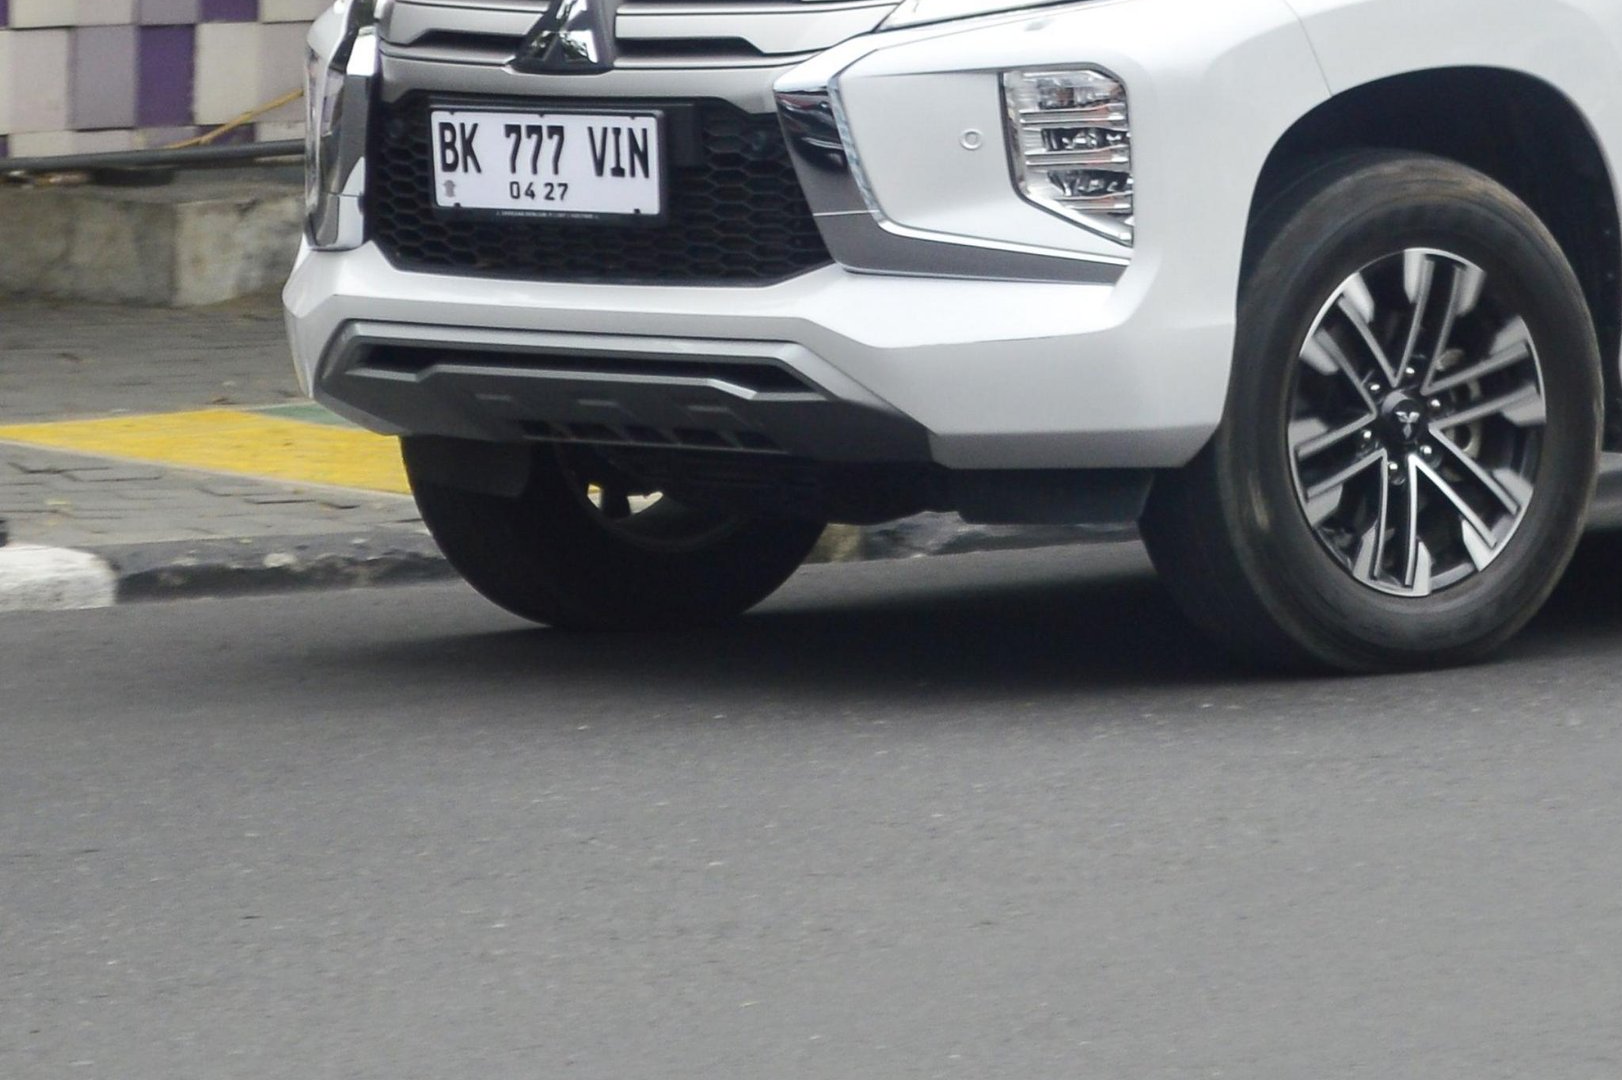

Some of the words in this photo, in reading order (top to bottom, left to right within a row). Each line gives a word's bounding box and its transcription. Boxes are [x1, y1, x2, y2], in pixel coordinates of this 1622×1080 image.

[438, 121, 482, 173] BK
[504, 123, 565, 175] 777
[587, 125, 650, 179] VIN
